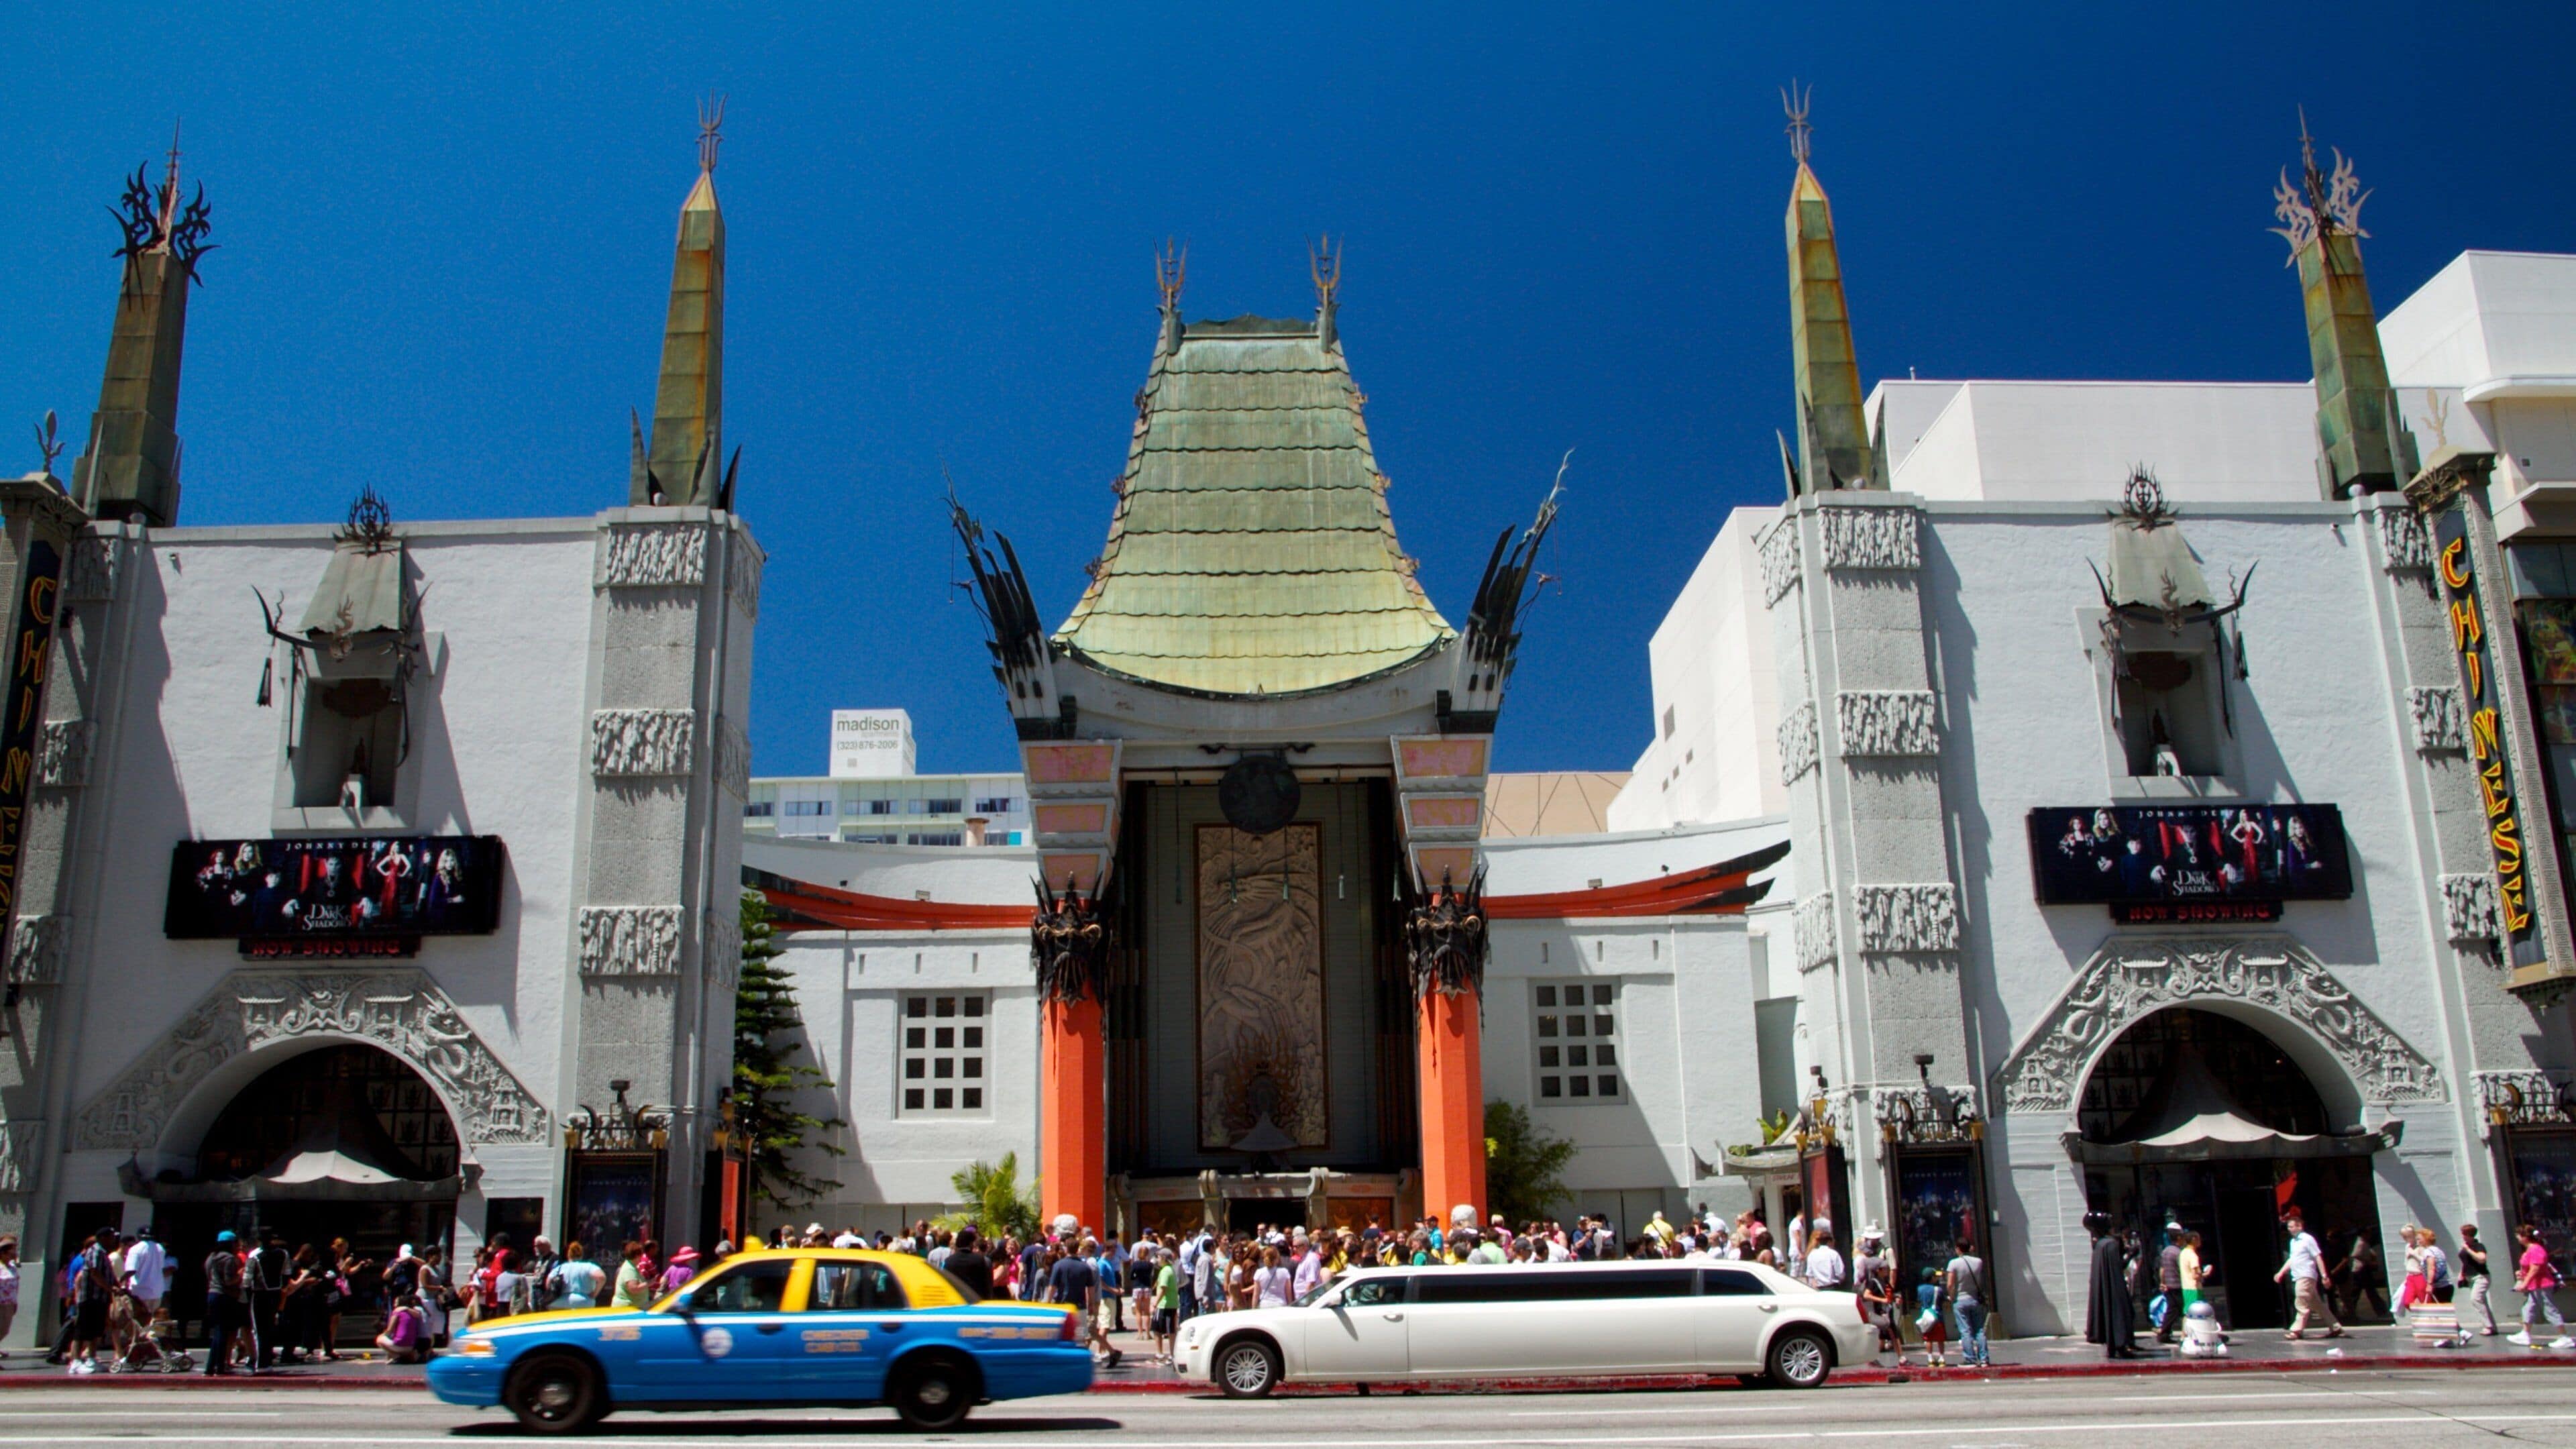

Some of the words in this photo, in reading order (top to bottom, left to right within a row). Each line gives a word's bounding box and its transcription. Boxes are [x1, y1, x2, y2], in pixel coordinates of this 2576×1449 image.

[837, 716, 900, 731] madison
[2442, 537, 2530, 933] CHINESE
[837, 741, 858, 751] (323)
[0, 576, 56, 936] CHINE
[285, 842, 345, 851] JOHNNY
[2129, 906, 2168, 920] NOW
[2177, 905, 2270, 919] SHOWING
[252, 941, 292, 955] NOW
[302, 940, 400, 955] SHOWING
